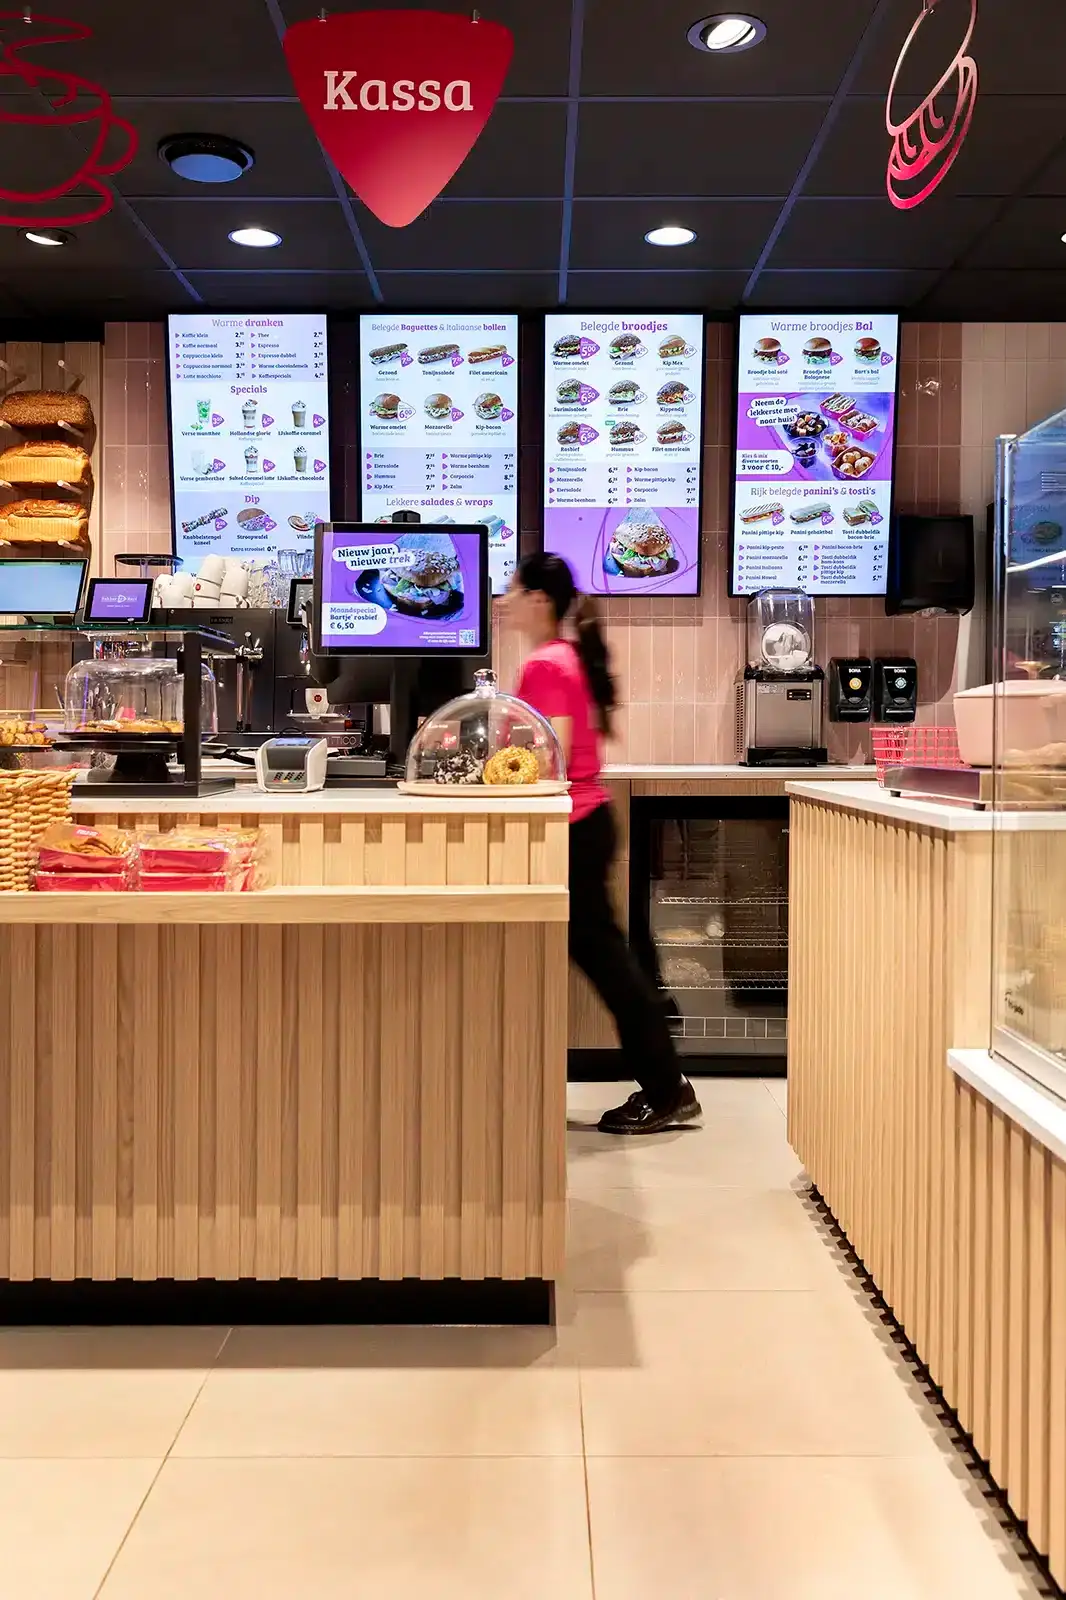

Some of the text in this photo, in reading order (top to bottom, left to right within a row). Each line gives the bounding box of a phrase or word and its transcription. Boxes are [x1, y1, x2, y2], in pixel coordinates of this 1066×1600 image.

[324, 71, 473, 111] Kassa
[212, 318, 284, 327] Warme dranken
[580, 321, 668, 333] Belegde broodjes
[771, 321, 873, 333] Warme broodjes Bal
[371, 324, 400, 332] Belegde
[401, 324, 438, 332] Baguettes
[230, 385, 268, 395] Specials
[750, 408, 782, 416] lekkerste
[751, 488, 767, 497] Rijk
[769, 488, 802, 497] belegde
[803, 487, 839, 497] panini's
[848, 487, 876, 495] tosti's
[244, 495, 260, 504] Dip
[338, 547, 396, 558] Nieuw jaar,
[350, 556, 411, 566] nieuwe trek
[337, 622, 354, 630] 6,50
